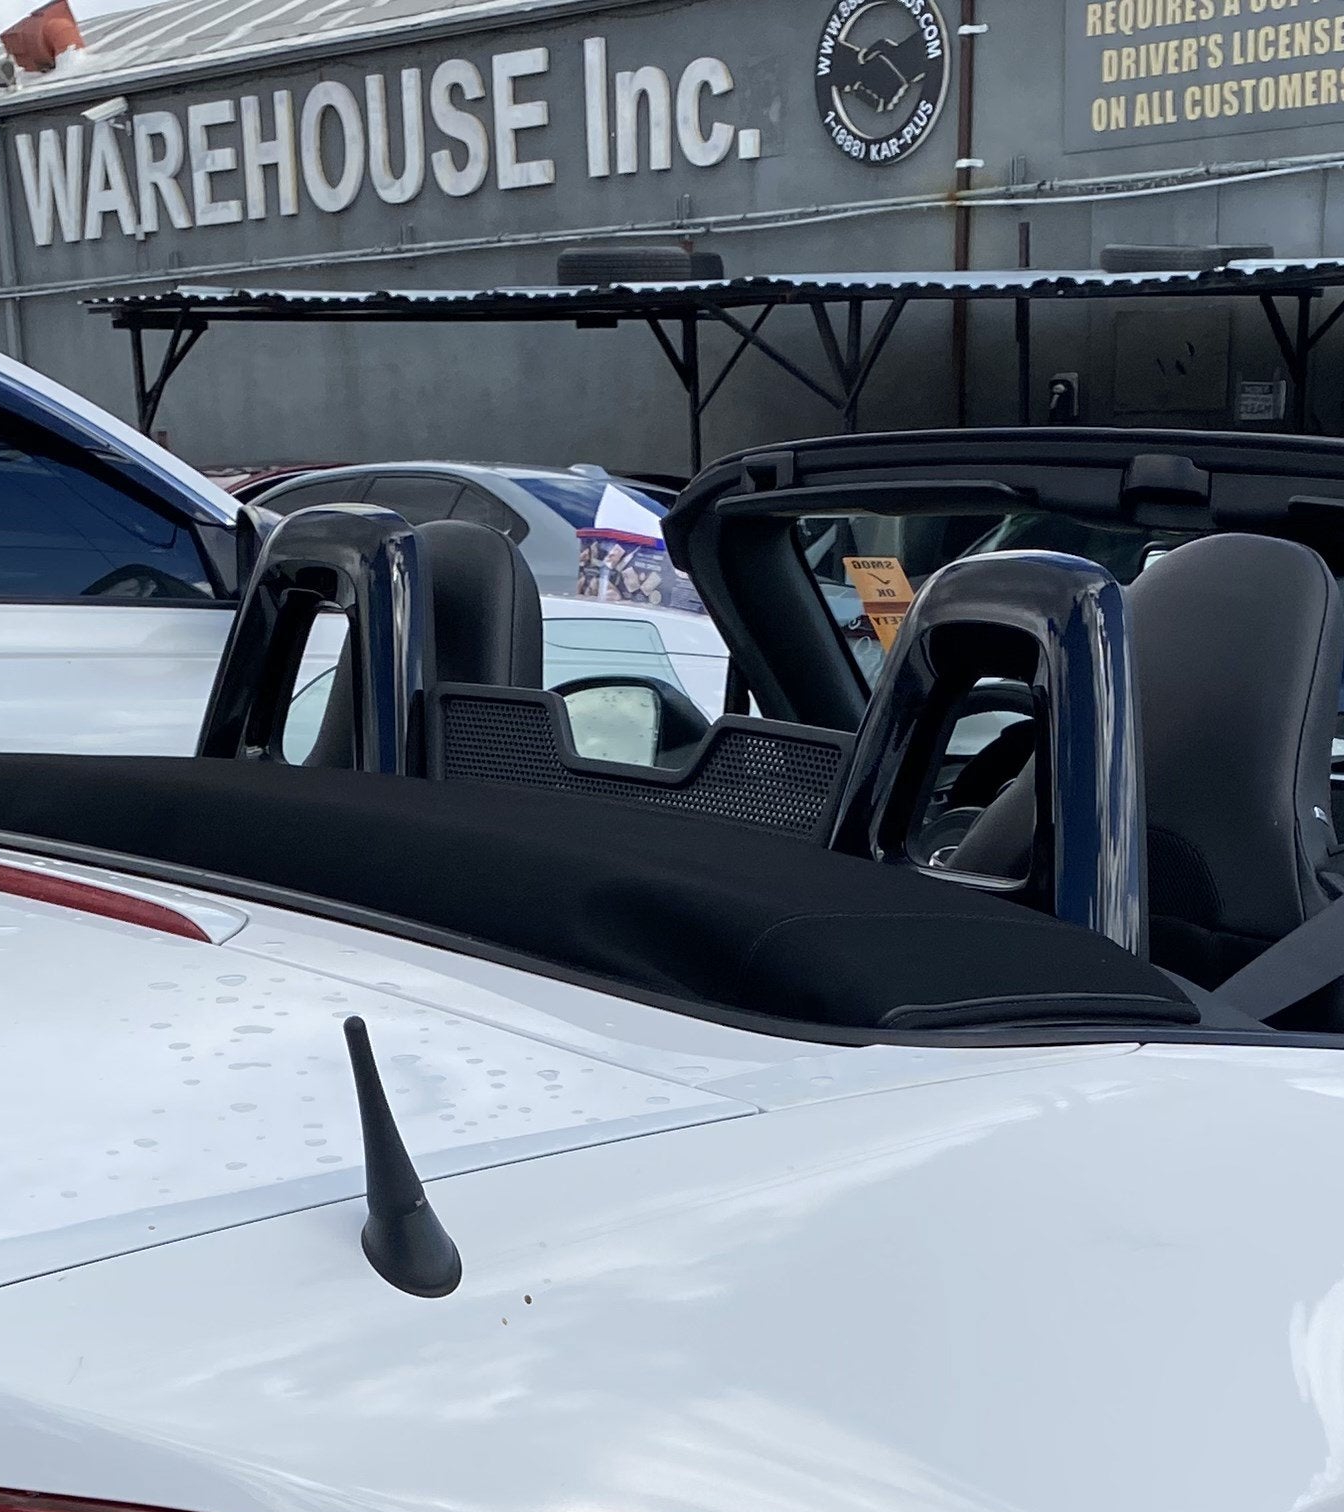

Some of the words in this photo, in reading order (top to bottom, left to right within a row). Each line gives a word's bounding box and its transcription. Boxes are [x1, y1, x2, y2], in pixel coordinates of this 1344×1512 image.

[1086, 0, 1215, 36] REQUIRES
[1102, 33, 1223, 82] DRIVER'S
[823, 111, 866, 160] 1-(888)
[869, 100, 934, 161] KAR-PLUS
[1091, 96, 1126, 132] ON
[1134, 89, 1178, 127] ALL
[16, 47, 555, 247] WAREHOUSE
[583, 36, 761, 178] Inc.
